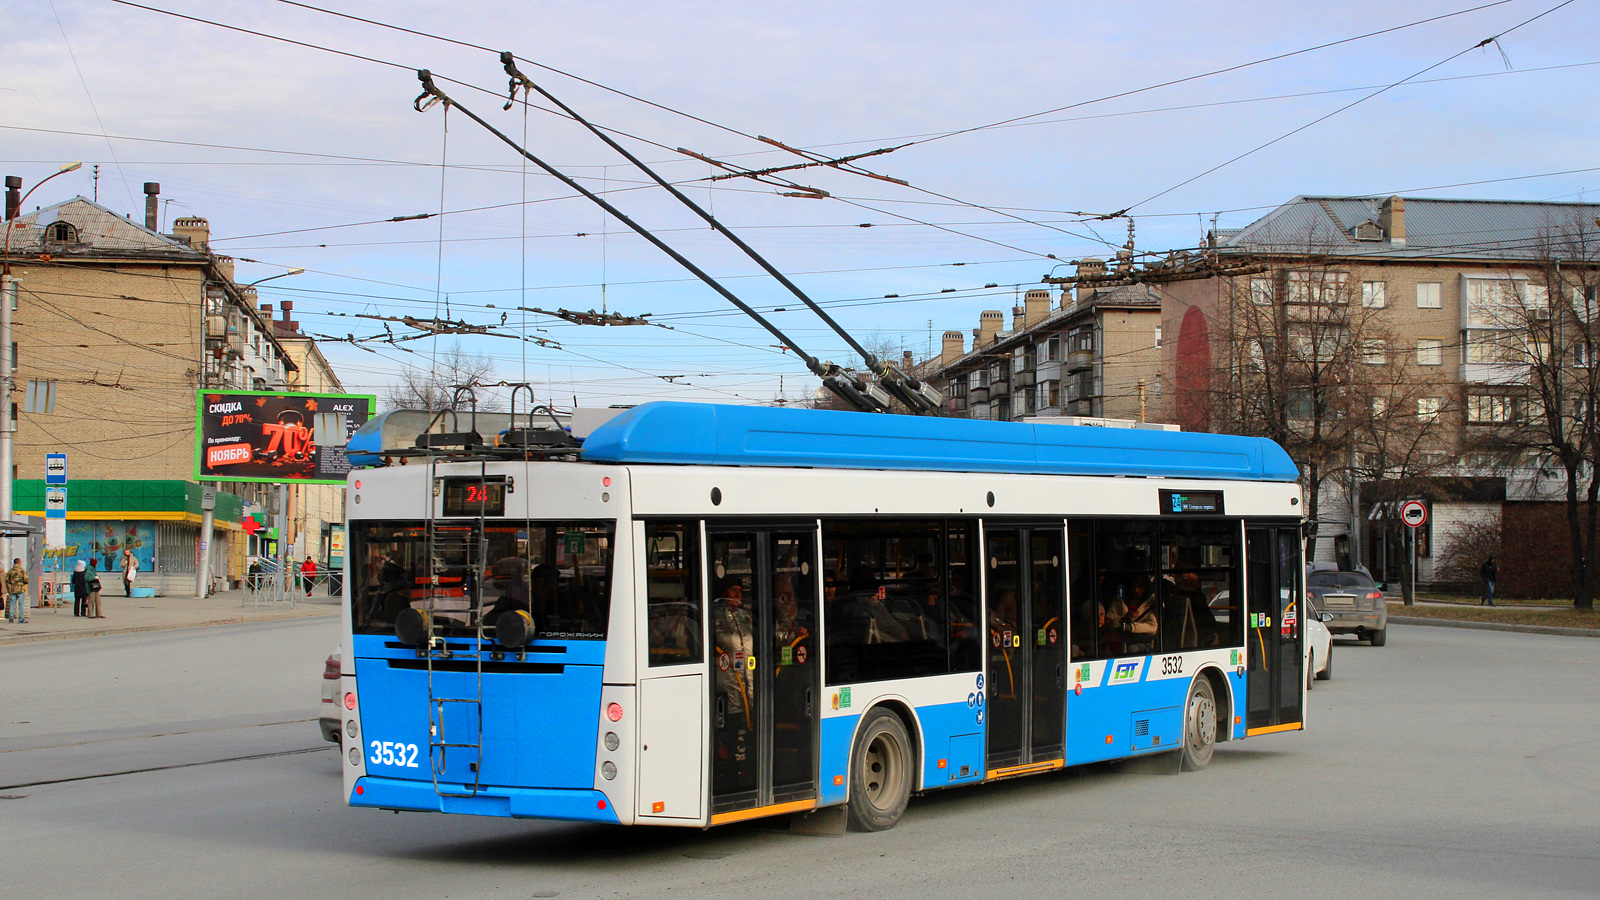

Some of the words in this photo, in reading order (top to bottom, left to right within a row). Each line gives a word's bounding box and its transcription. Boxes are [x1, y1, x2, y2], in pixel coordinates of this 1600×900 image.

[209, 401, 242, 414] СКИДКА
[333, 404, 354, 412] ALEX
[221, 415, 234, 427] ДО
[235, 413, 252, 425] 70%
[262, 422, 316, 457] 70%
[210, 450, 248, 462] НОЯБРЬ
[539, 631, 604, 639] ГОРОЖАНИН
[1162, 655, 1182, 675] 3532
[370, 740, 419, 768] 3532
